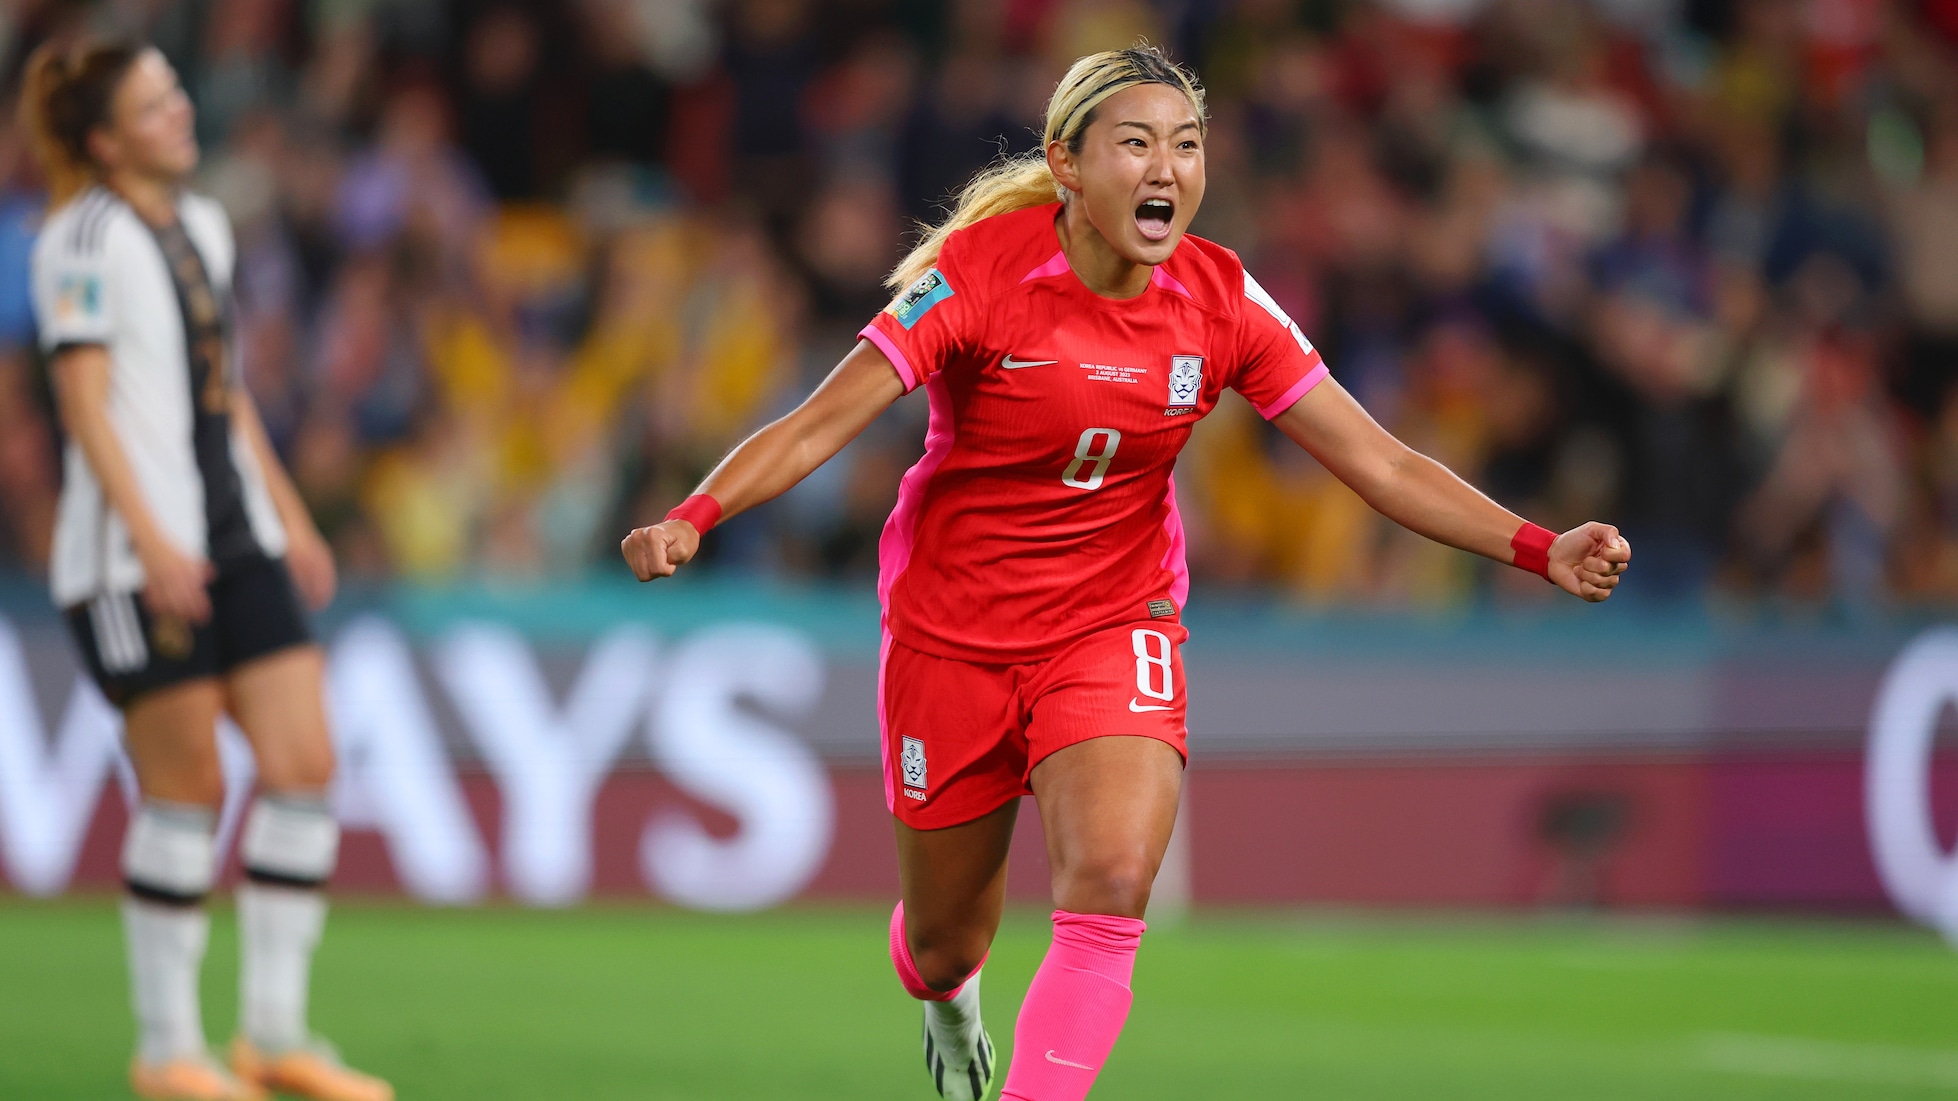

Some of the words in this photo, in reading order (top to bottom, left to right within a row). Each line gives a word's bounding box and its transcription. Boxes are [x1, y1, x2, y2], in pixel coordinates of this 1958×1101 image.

[1163, 408, 1193, 416] KOREA
[1061, 427, 1122, 491] 8
[1131, 628, 1174, 702] 8
[904, 788, 927, 801] KOREA
